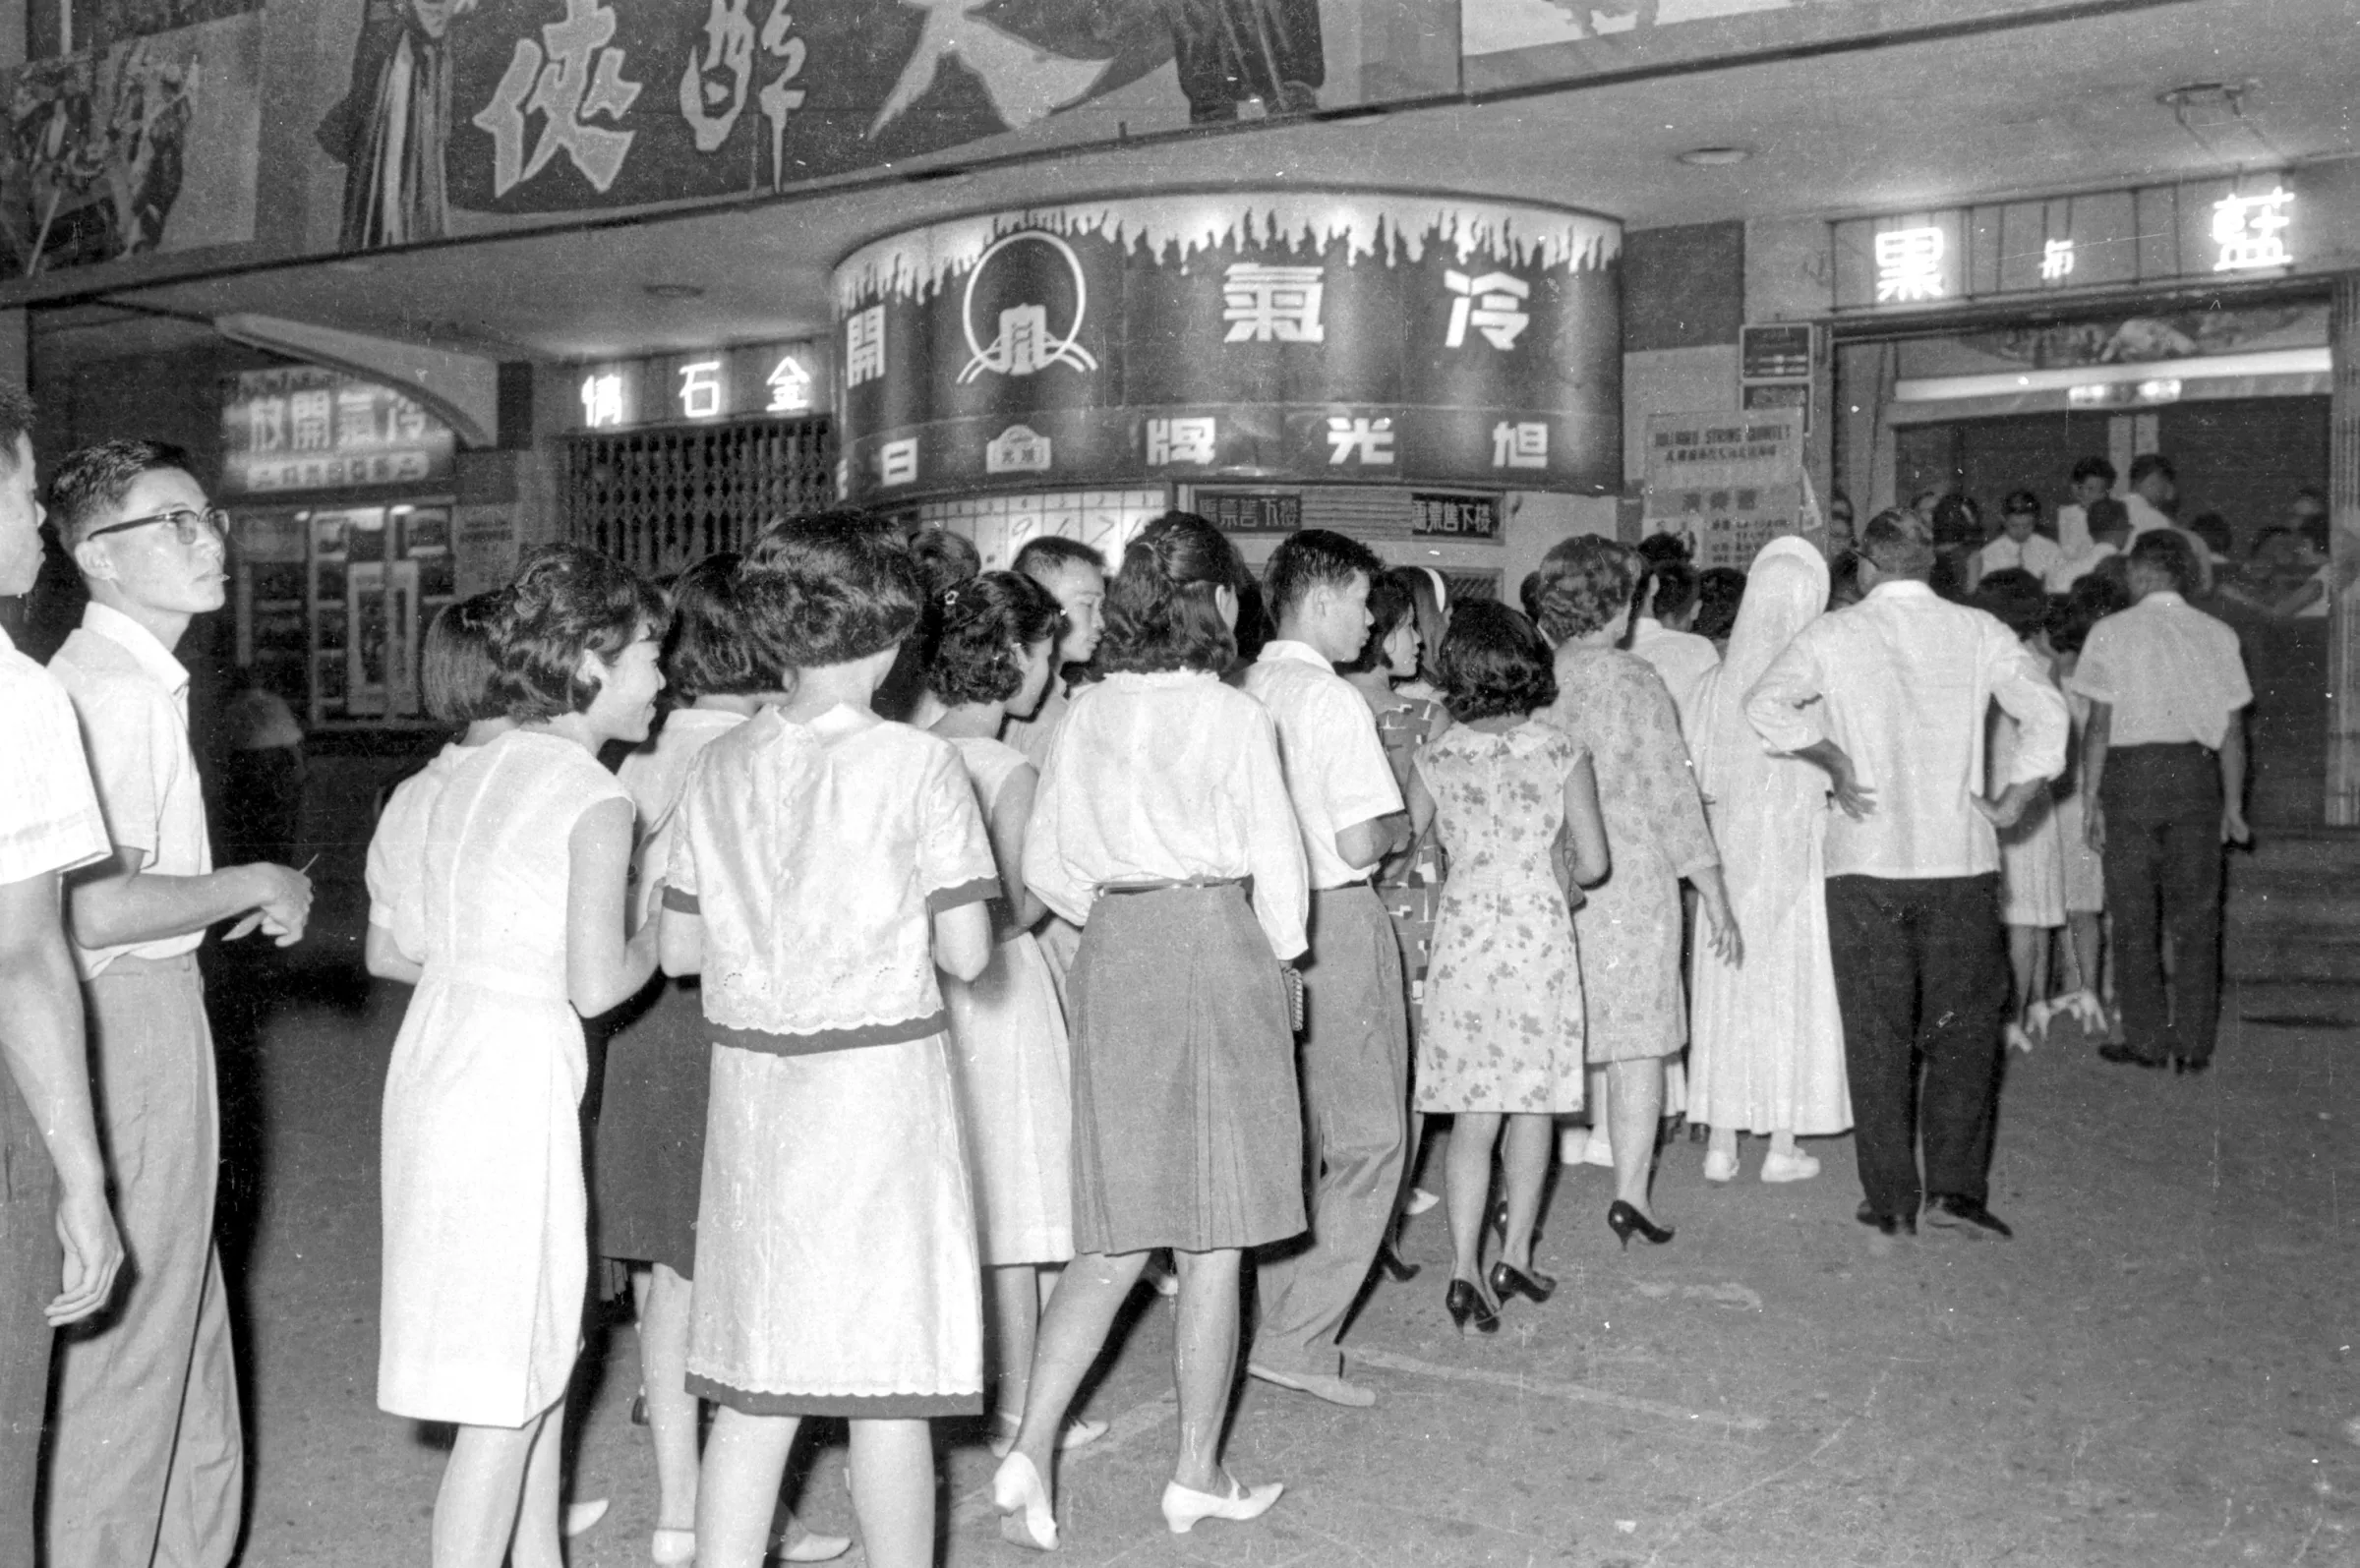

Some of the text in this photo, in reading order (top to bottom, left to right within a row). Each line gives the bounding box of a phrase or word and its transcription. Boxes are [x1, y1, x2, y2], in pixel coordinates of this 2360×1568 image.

[847, 261, 1531, 389] 冷氣 開
[1147, 417, 1549, 469] 旭光牌
